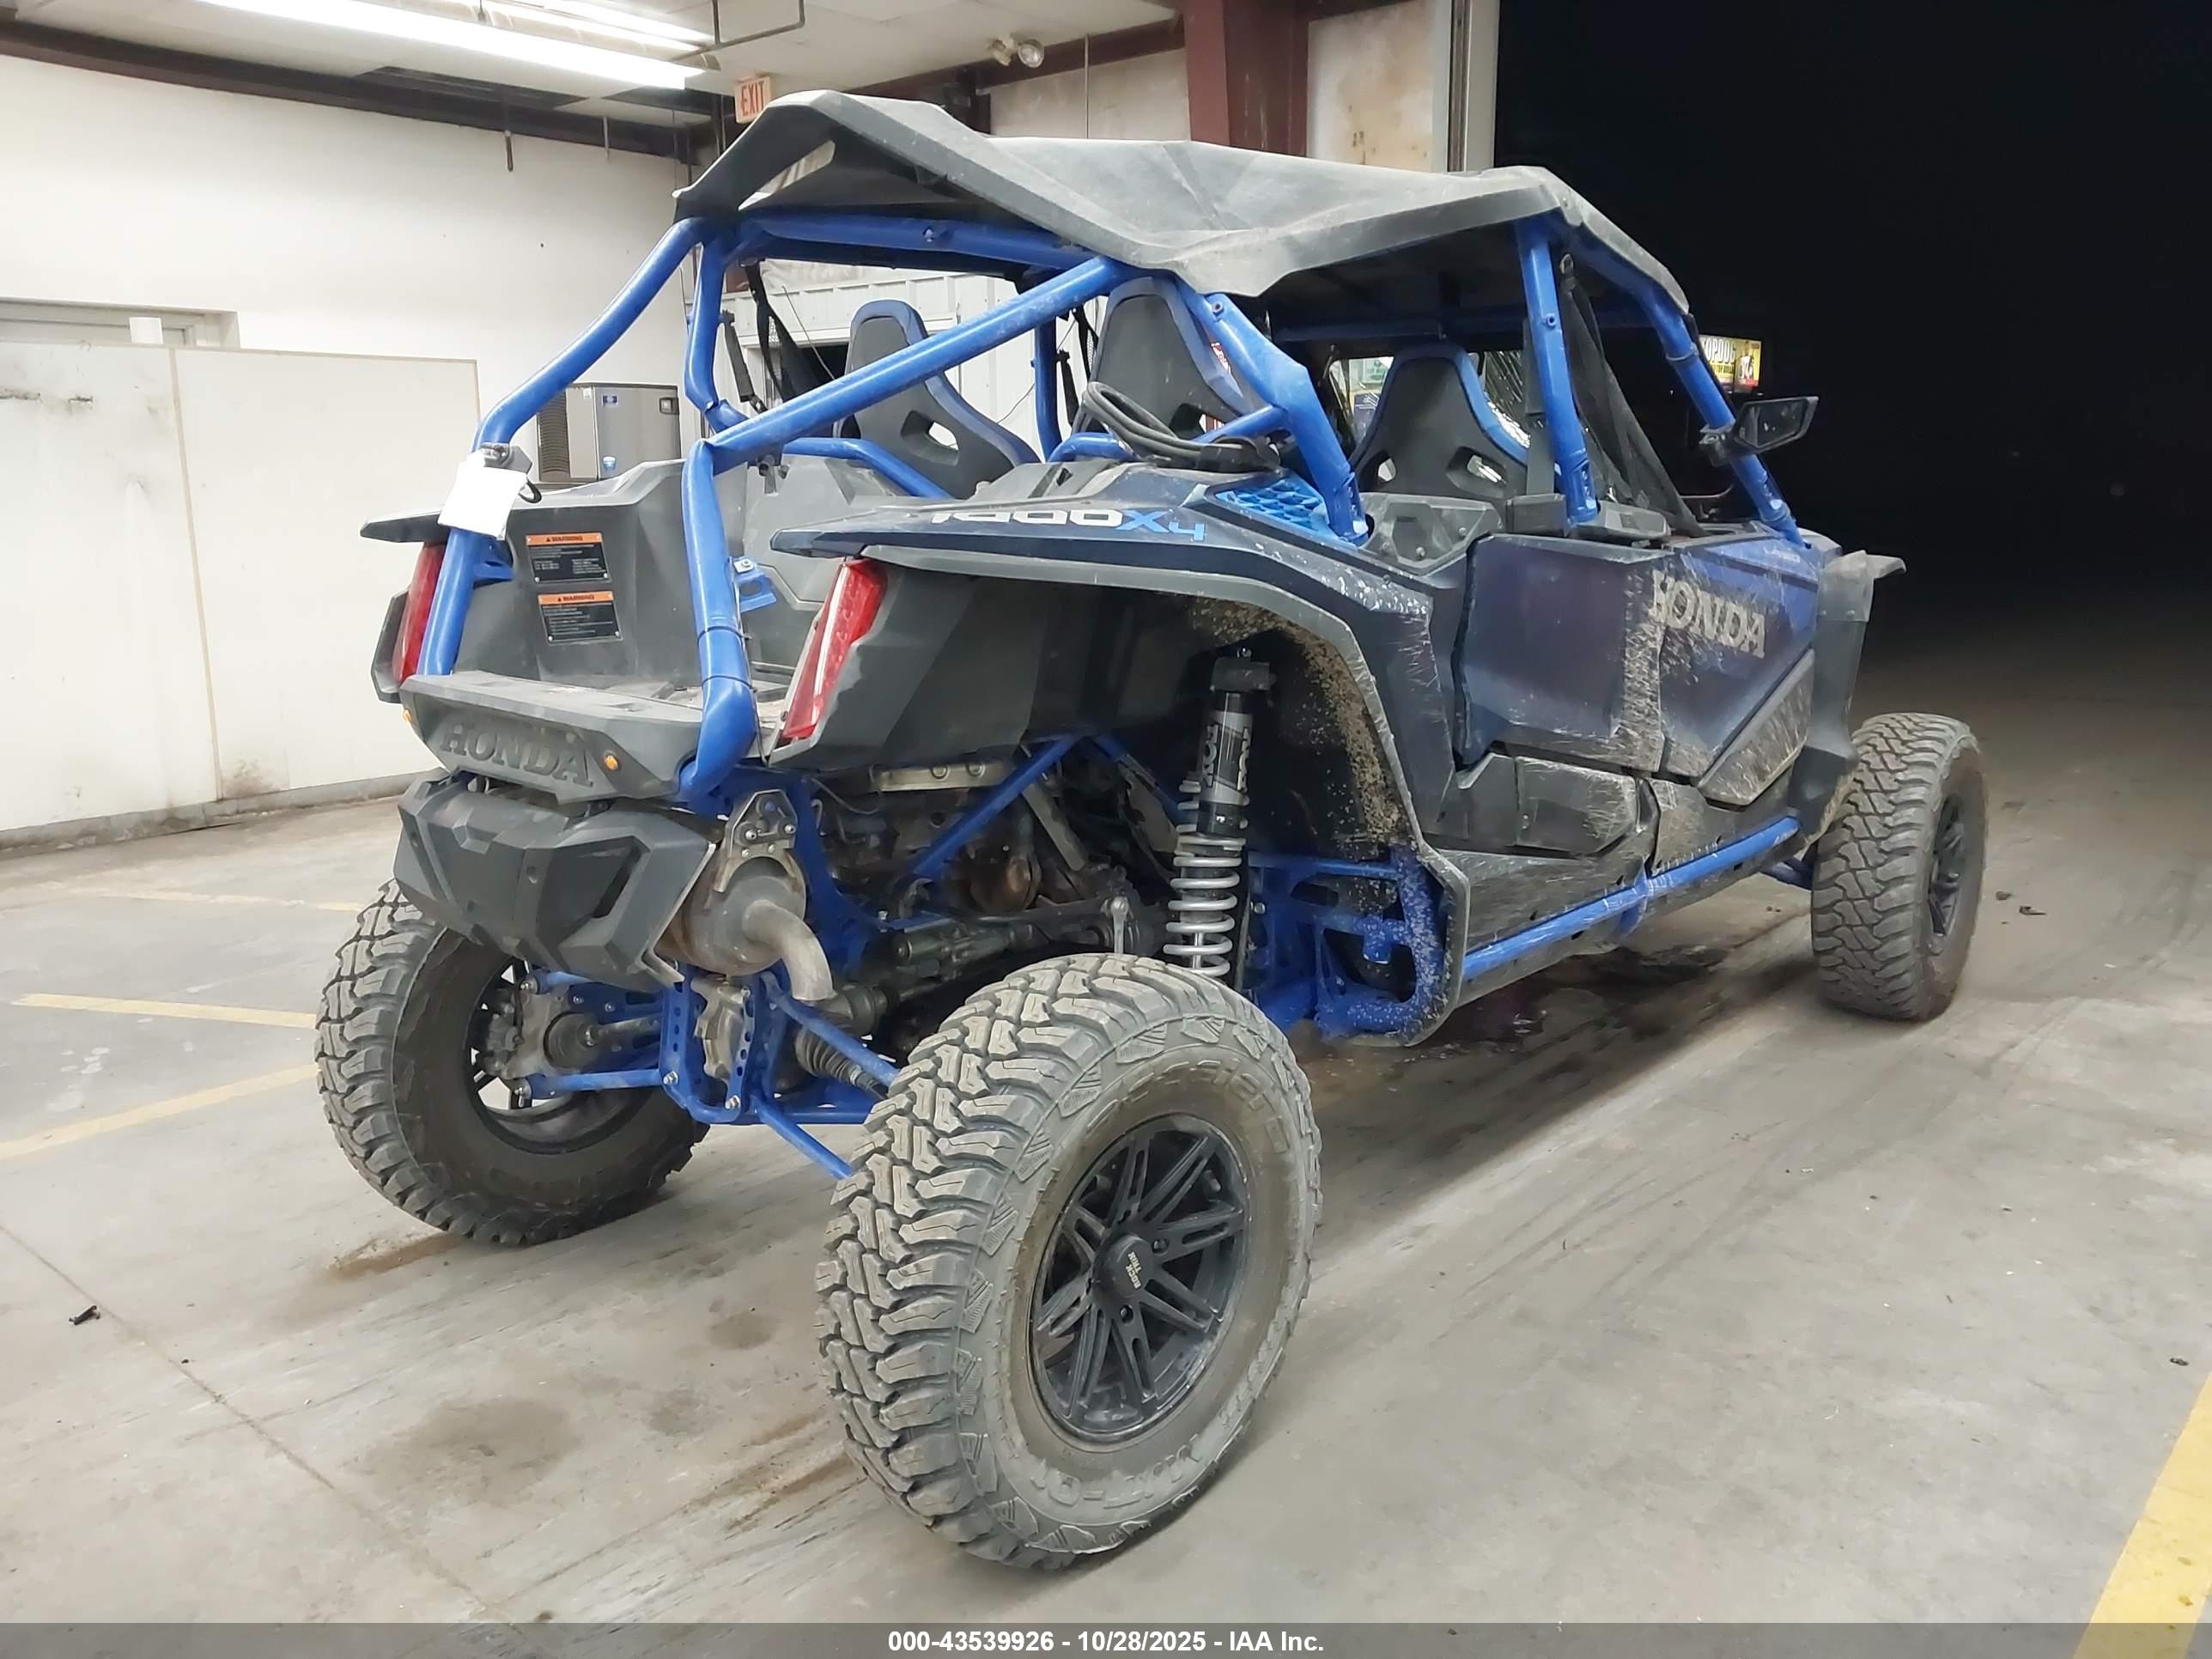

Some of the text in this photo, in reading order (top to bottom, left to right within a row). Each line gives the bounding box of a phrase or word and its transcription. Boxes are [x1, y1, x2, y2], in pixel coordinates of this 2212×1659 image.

[741, 81, 764, 117] EXIT
[1649, 569, 1765, 659] HONDA
[440, 723, 593, 787] HONDA
[1126, 1264, 1141, 1289] ROCK
